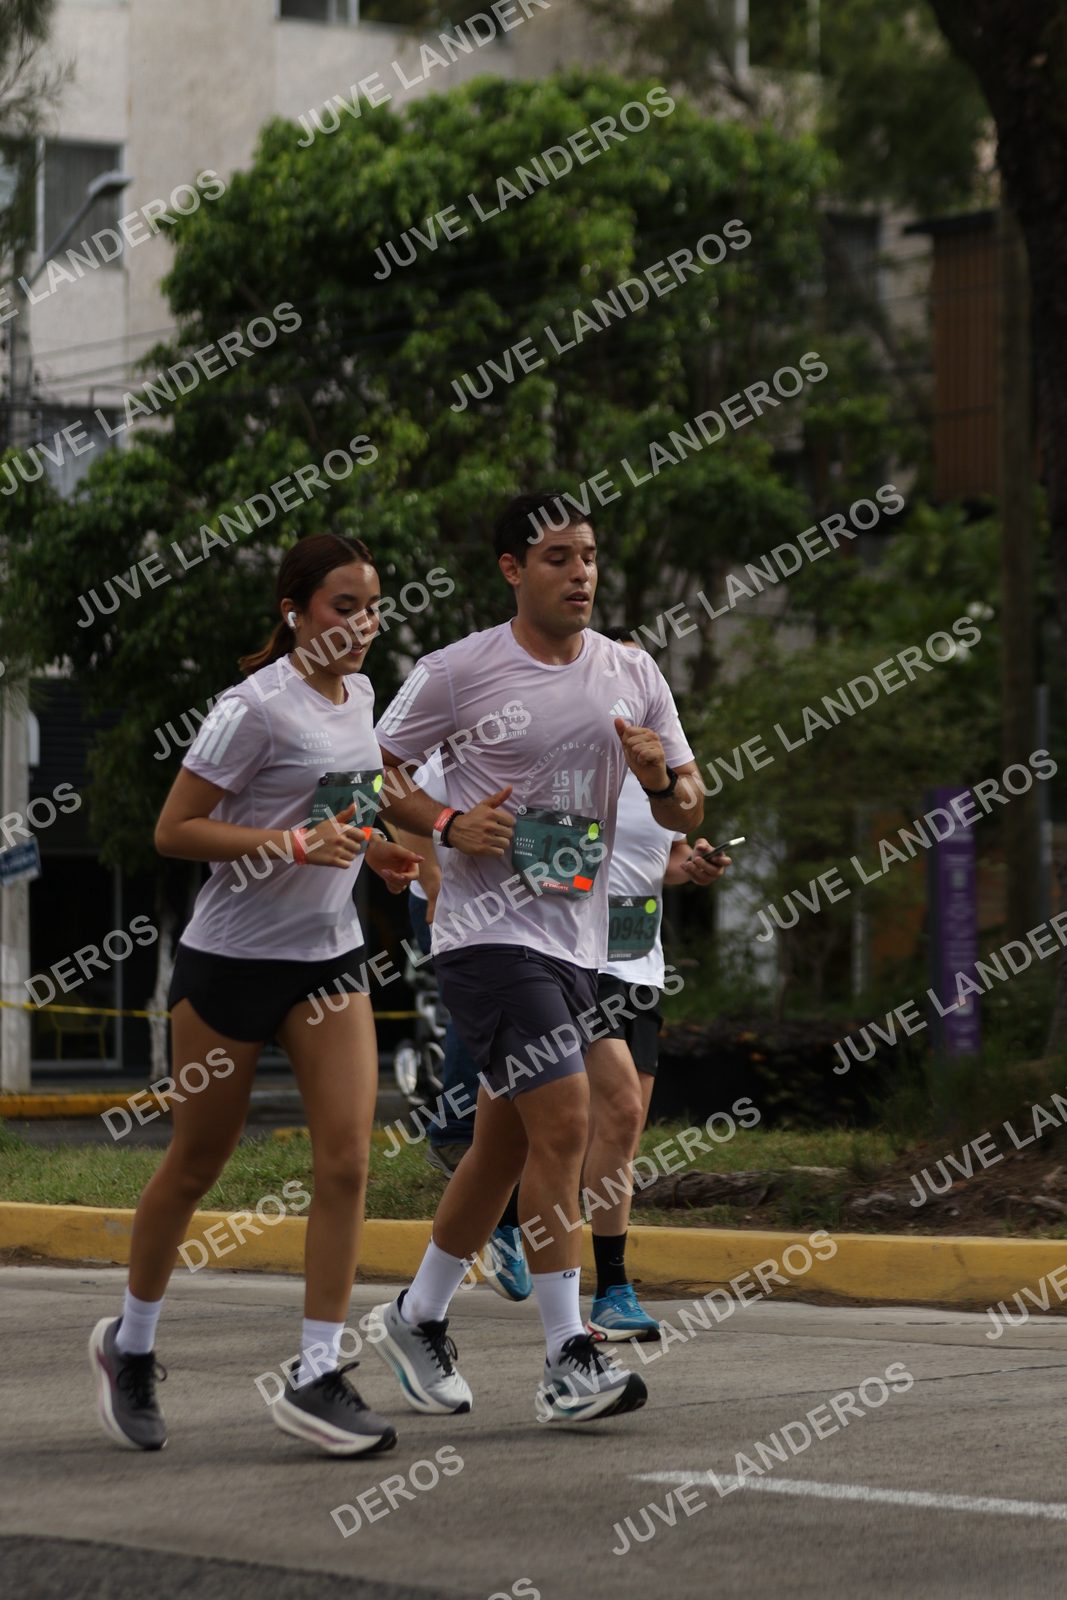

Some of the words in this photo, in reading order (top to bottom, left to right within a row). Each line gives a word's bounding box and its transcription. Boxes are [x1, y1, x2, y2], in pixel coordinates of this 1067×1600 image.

[551, 769, 571, 788] 15
[573, 768, 597, 811] K
[551, 794, 571, 812] 30
